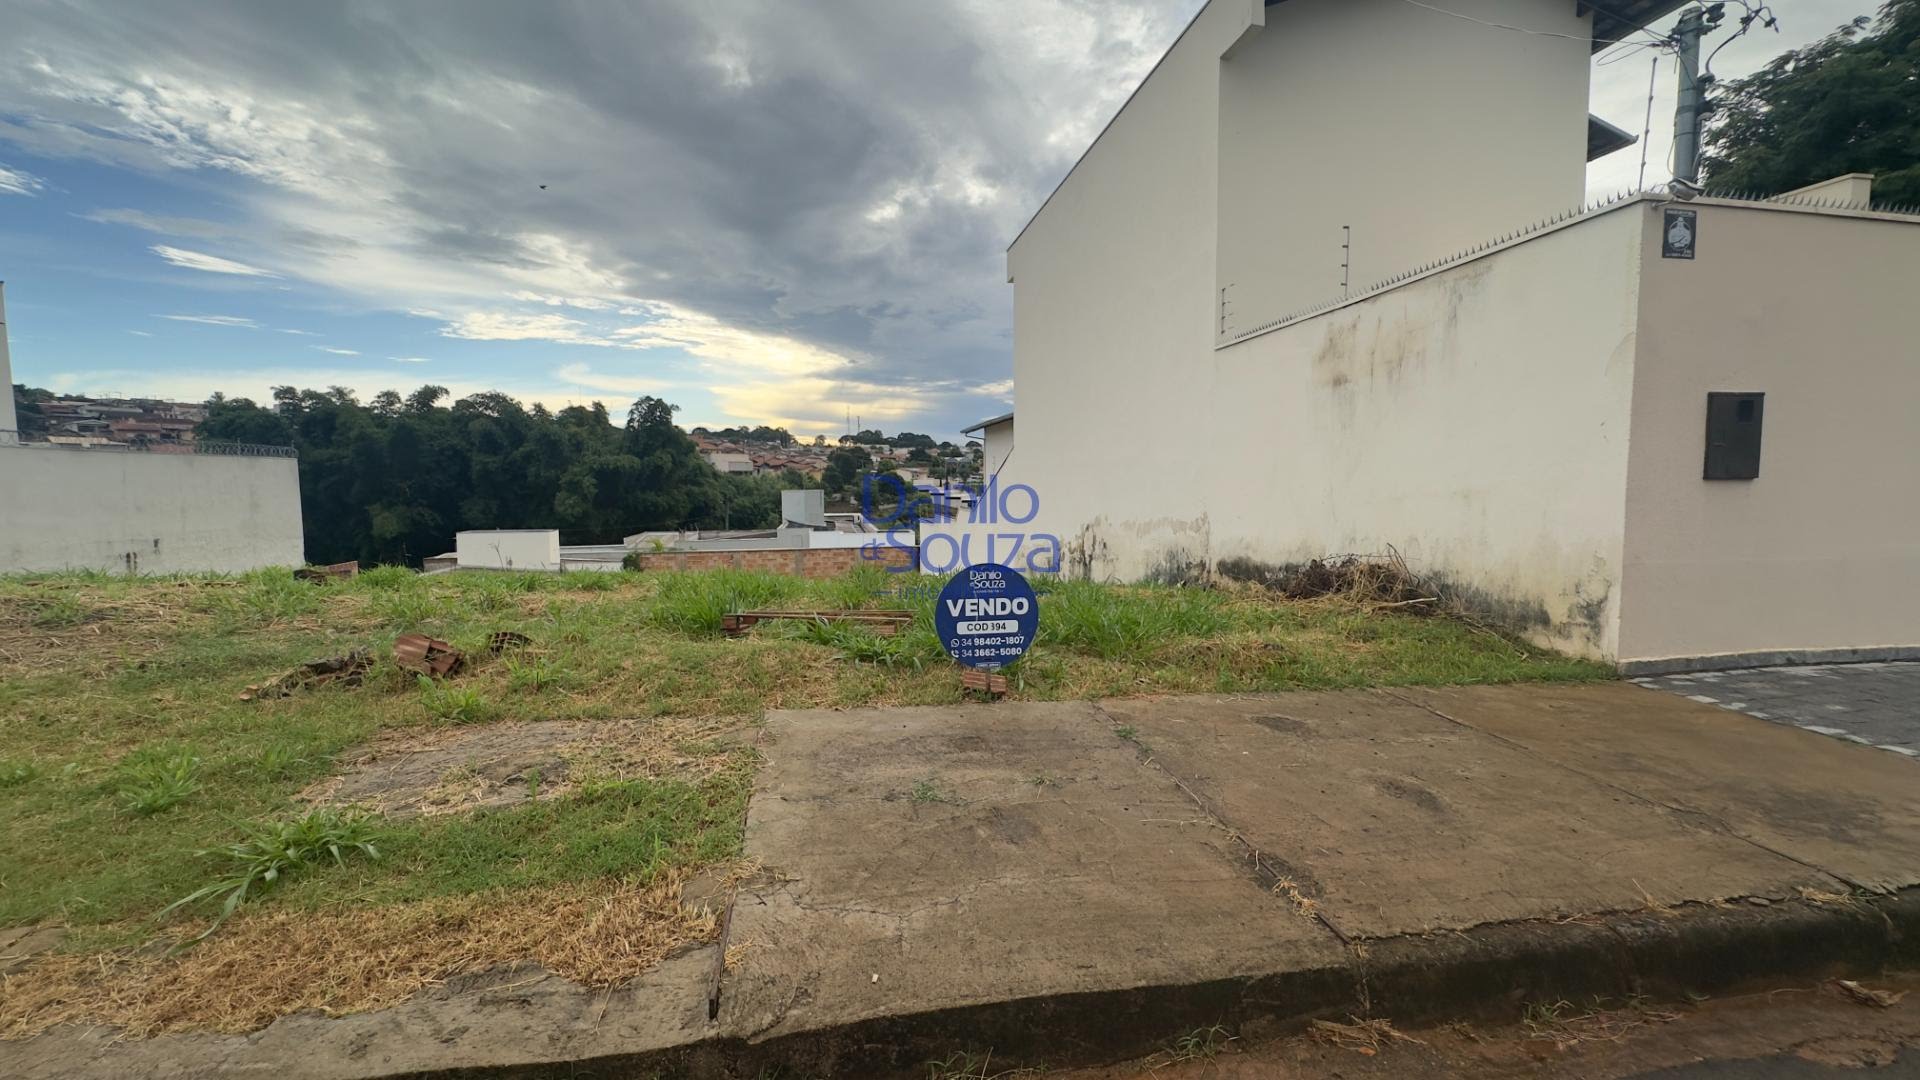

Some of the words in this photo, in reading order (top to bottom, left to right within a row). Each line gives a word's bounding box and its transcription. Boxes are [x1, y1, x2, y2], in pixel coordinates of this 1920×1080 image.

[974, 580, 1006, 588] Souza
[946, 597, 1029, 617] VENDO
[967, 623, 988, 631] COD
[961, 638, 972, 646] 34
[974, 636, 1024, 646] 98402-1807
[961, 649, 972, 657] 34
[974, 647, 1022, 657] 3662-5080
